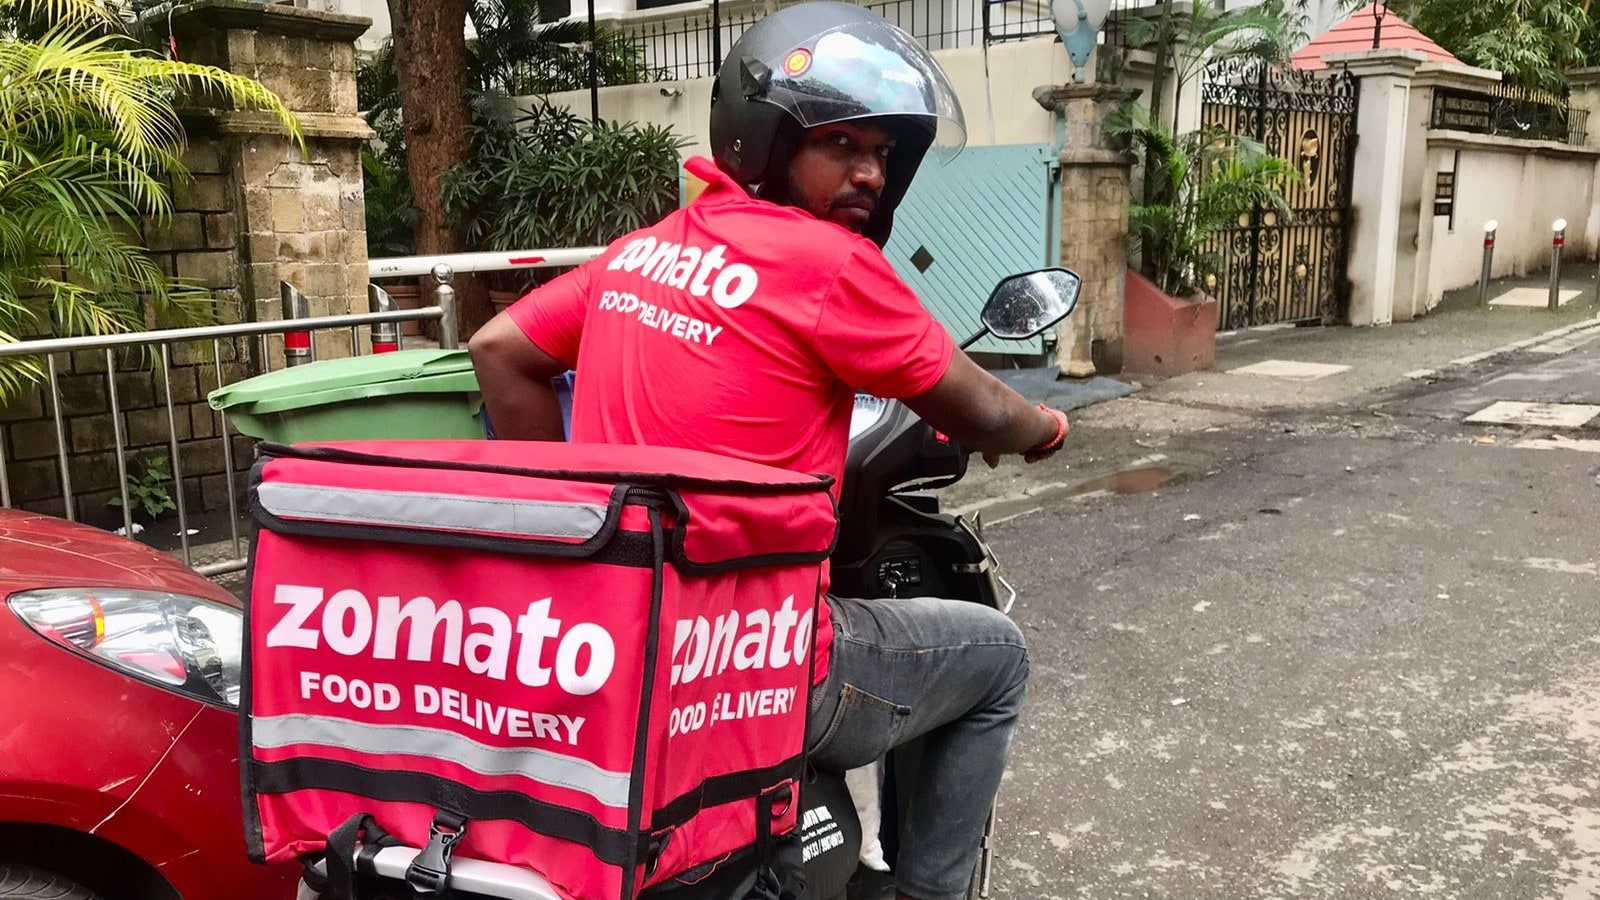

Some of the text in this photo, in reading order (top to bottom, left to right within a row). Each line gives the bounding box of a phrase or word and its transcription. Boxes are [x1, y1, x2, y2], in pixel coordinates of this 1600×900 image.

[600, 290, 640, 313] FOOD
[608, 236, 758, 308] zomato
[266, 584, 616, 696] zomato
[300, 671, 586, 747] FOOD DELIVERY
[669, 701, 707, 739] OOD
